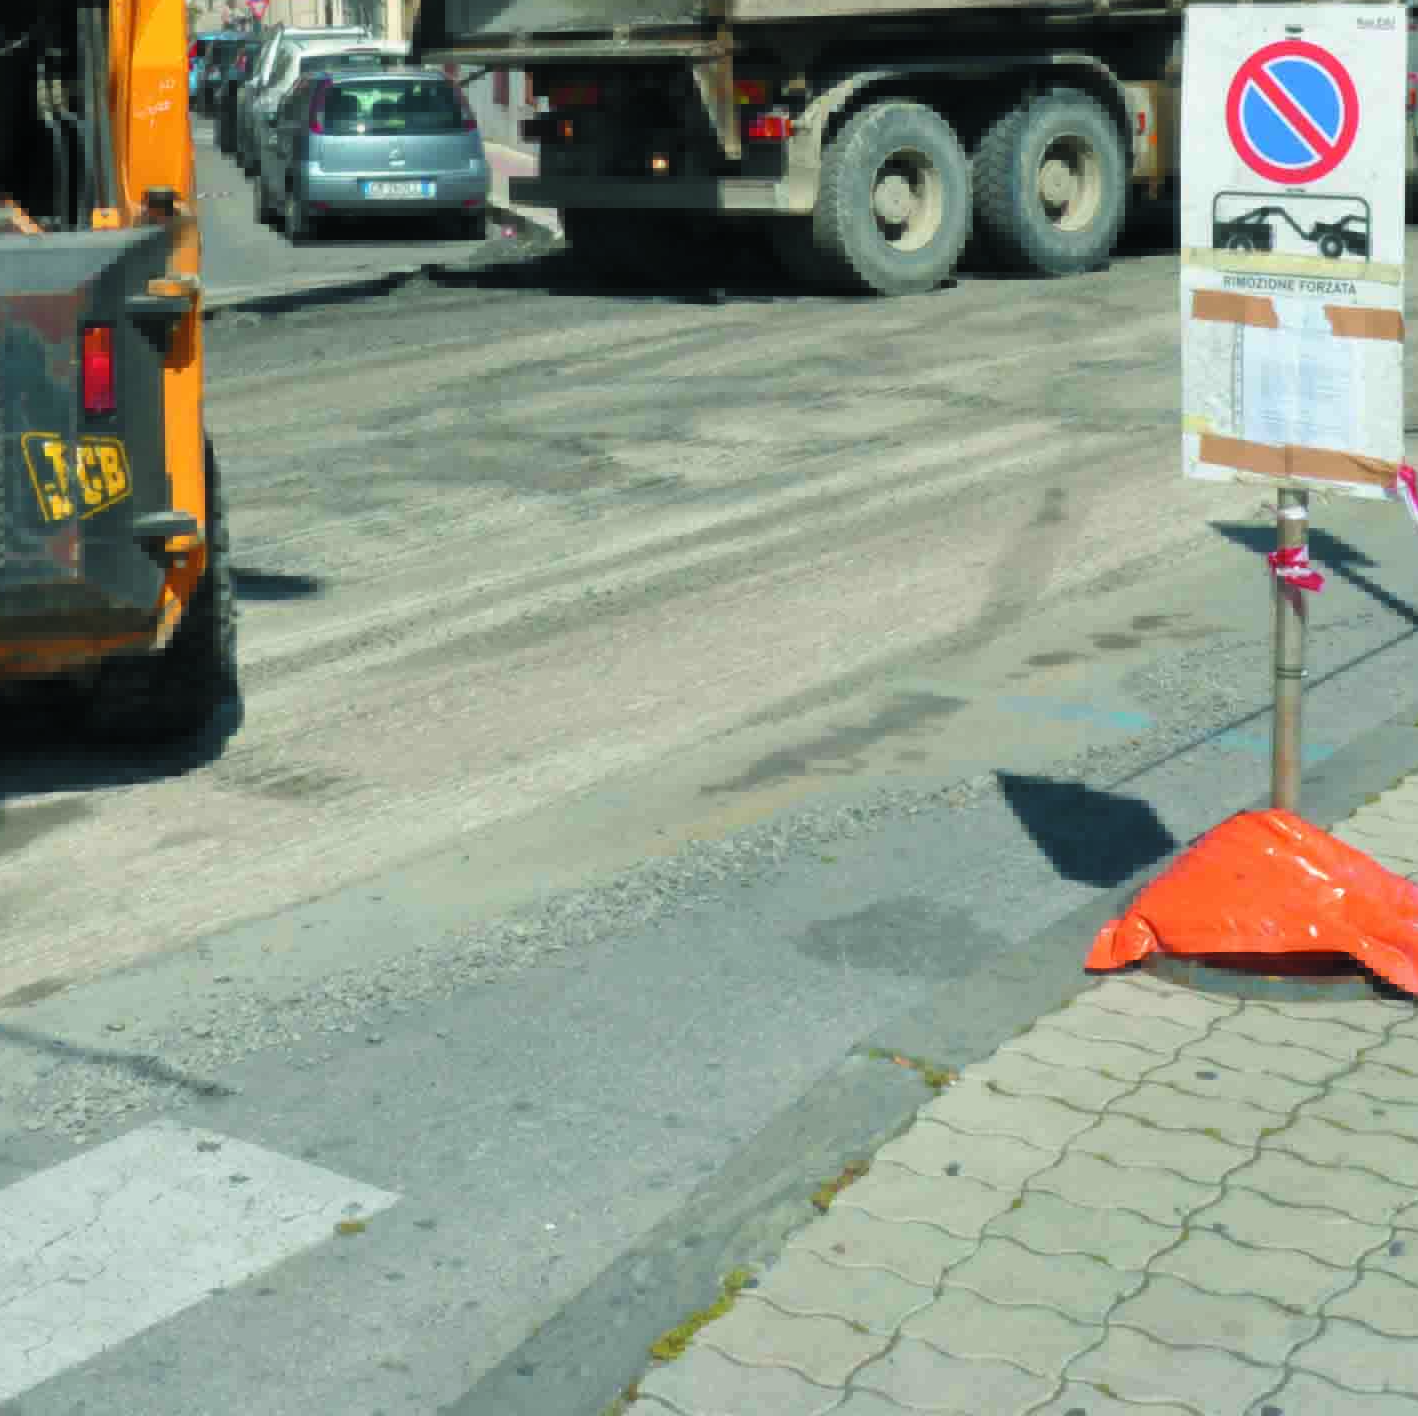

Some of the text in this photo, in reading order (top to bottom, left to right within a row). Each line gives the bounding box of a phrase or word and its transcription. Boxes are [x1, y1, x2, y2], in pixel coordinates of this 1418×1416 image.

[1222, 274, 1358, 296] RIMOZIONE FORZATA
[41, 441, 127, 520] JCB
